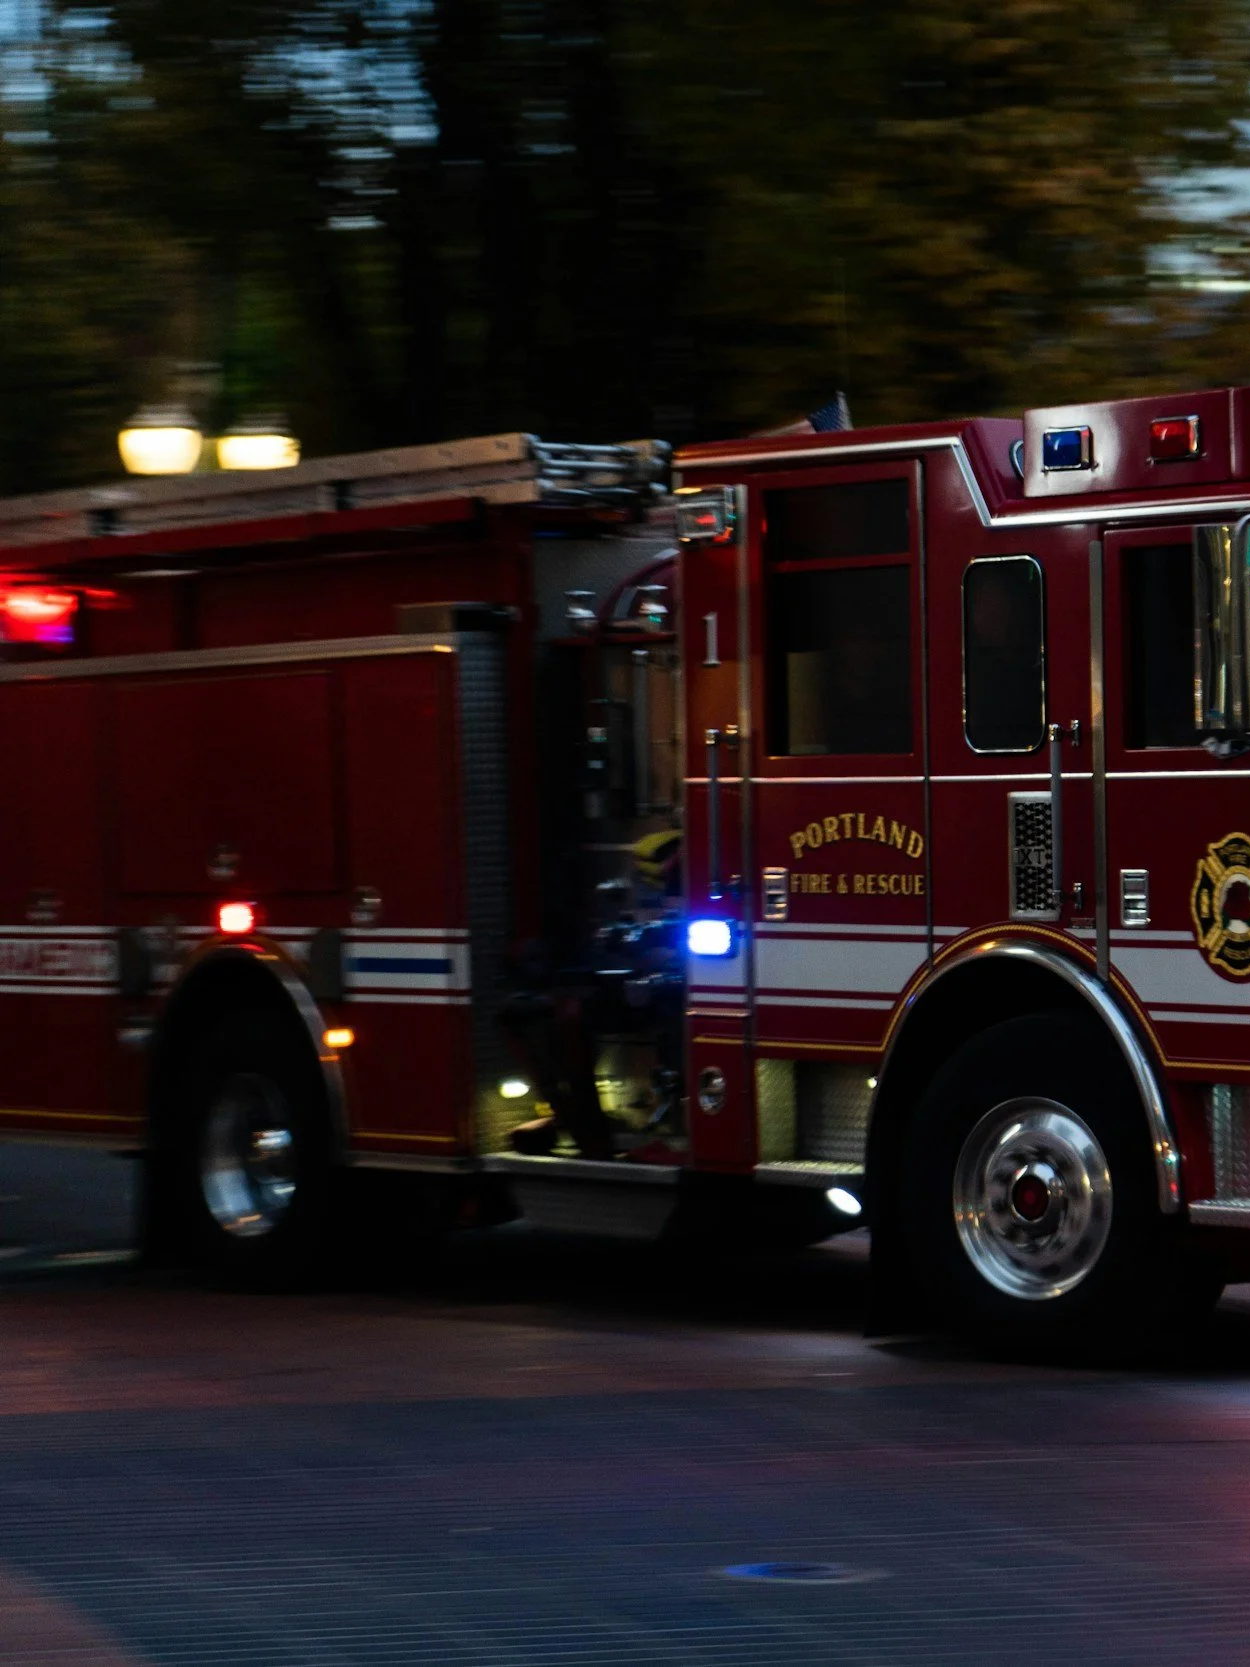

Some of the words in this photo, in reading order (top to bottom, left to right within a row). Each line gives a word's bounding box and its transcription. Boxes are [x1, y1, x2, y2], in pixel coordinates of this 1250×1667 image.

[702, 613, 723, 665] 1
[788, 812, 925, 860] PORTLAND
[789, 872, 833, 894] FIRE
[836, 872, 849, 895] &
[852, 873, 926, 895] RESCUE
